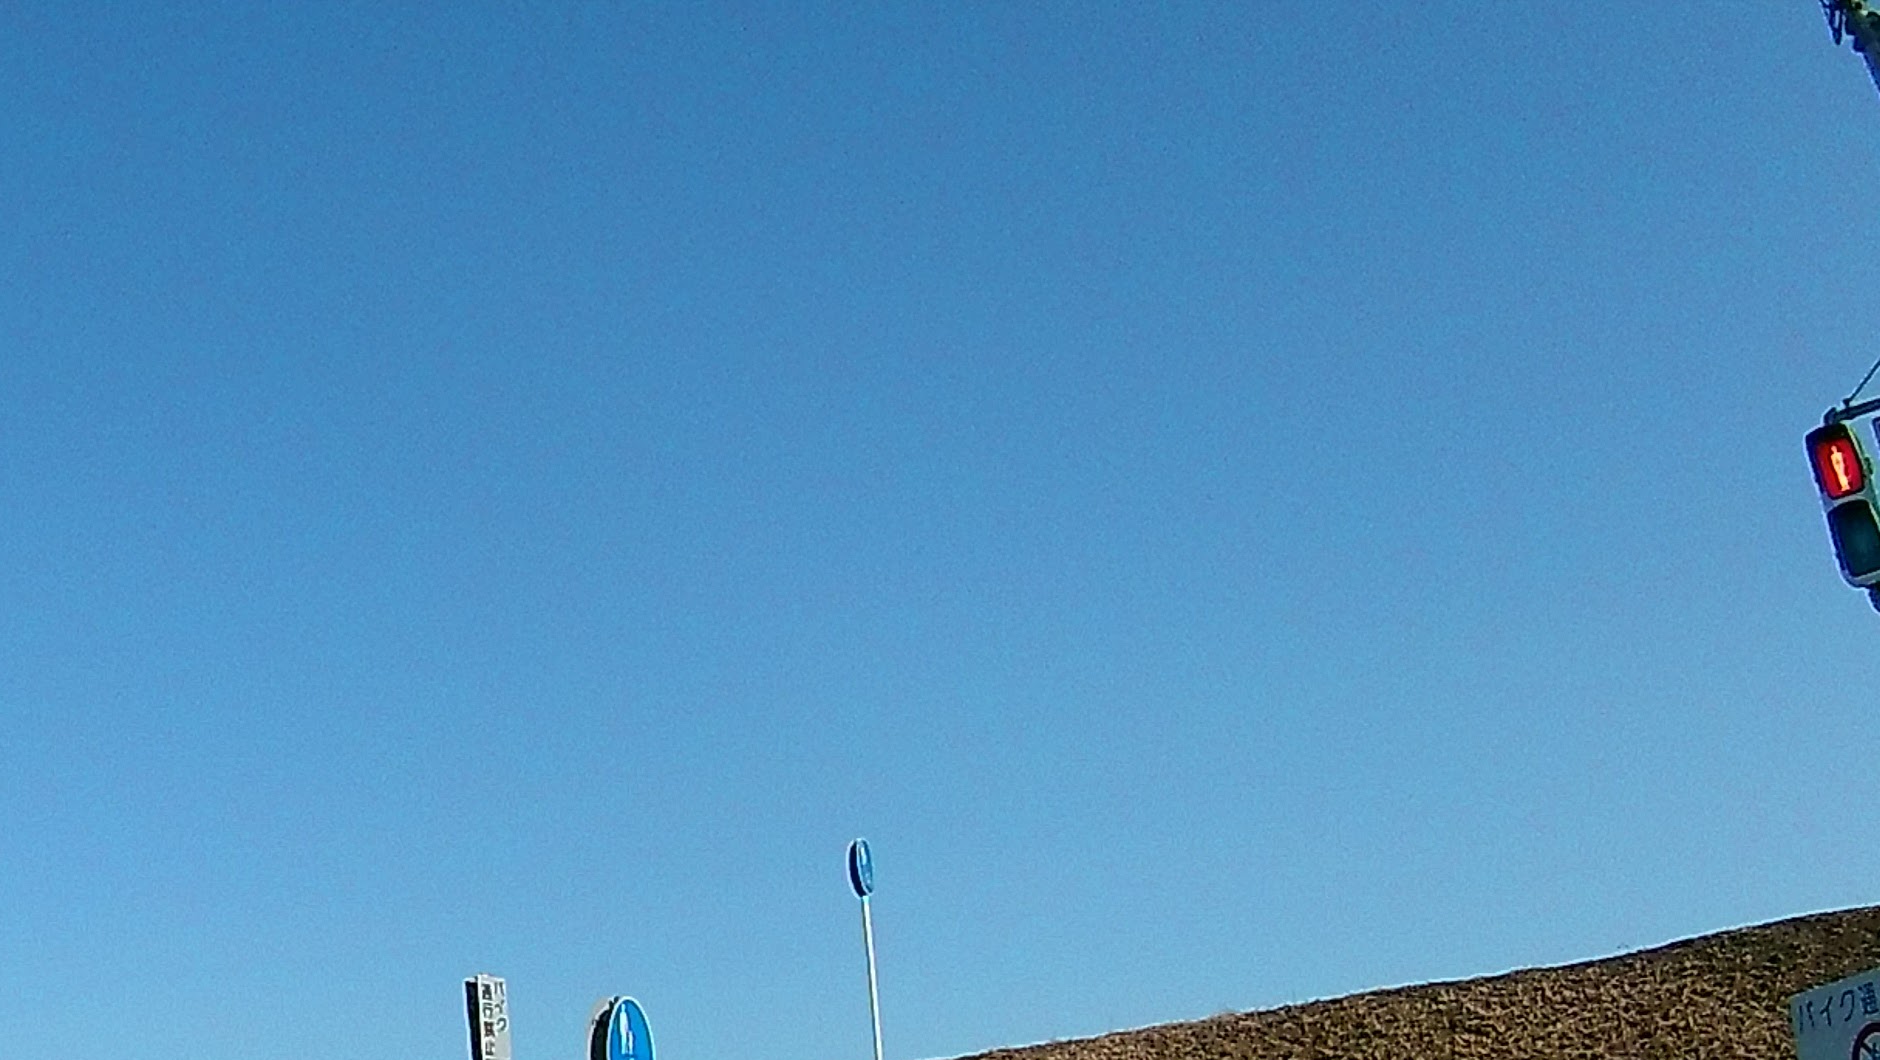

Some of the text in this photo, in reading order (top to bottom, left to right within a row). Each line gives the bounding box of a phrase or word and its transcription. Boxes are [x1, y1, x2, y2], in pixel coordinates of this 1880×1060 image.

[482, 983, 496, 1056] 通行禁止
[1799, 981, 1879, 1034] バイク通
